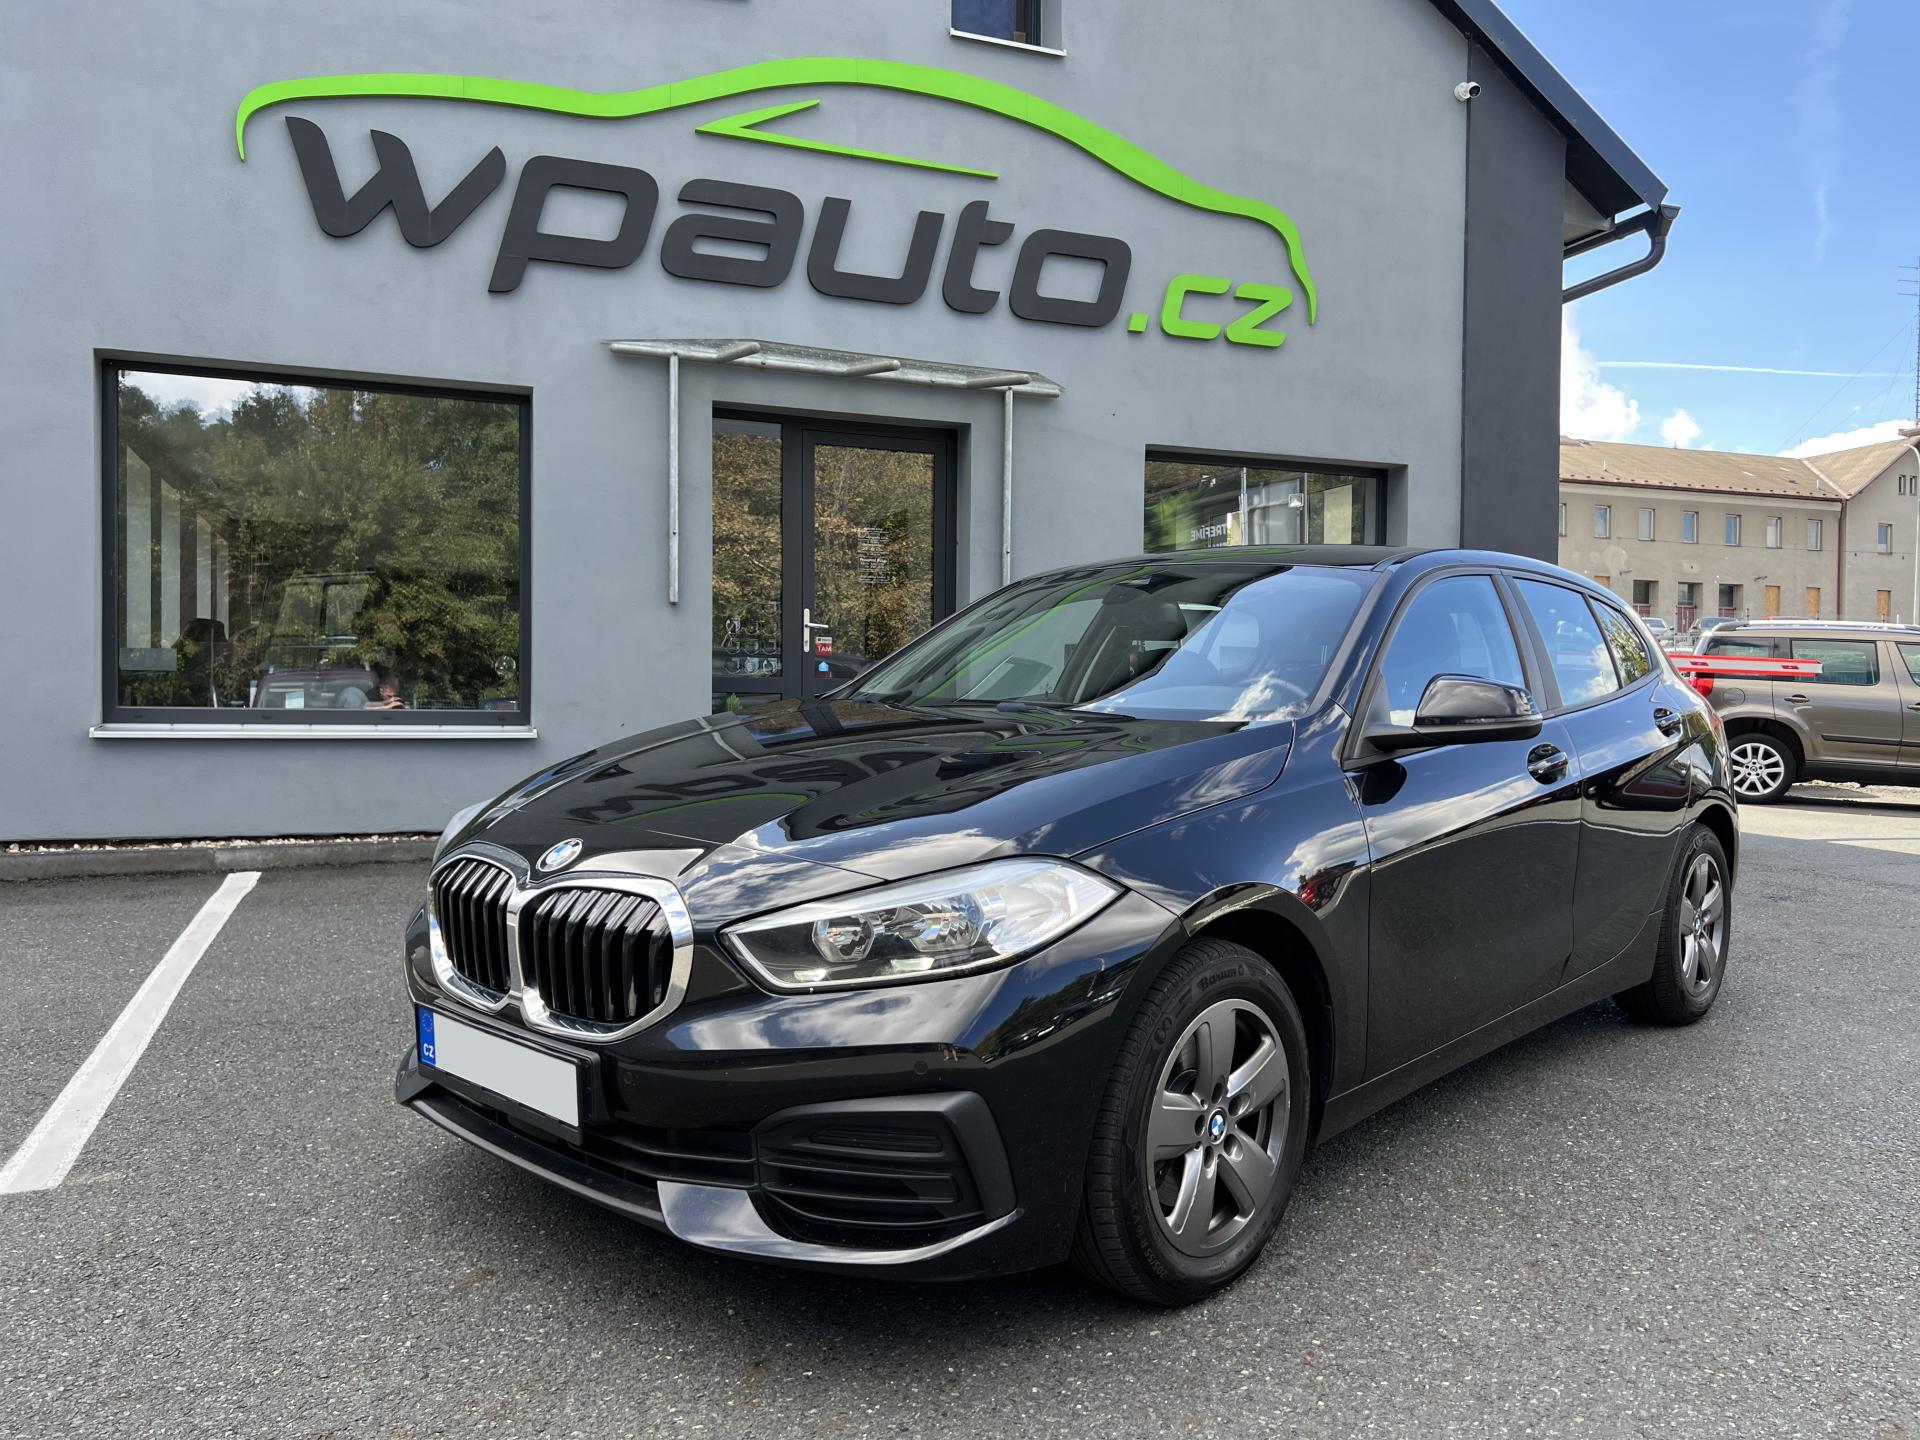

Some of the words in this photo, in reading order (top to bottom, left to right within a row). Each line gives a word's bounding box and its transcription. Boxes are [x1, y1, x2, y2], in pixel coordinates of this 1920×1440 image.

[285, 116, 1293, 348] wpauto.cz
[1198, 967, 1236, 991] Barum
[423, 1043, 434, 1058] CZ
